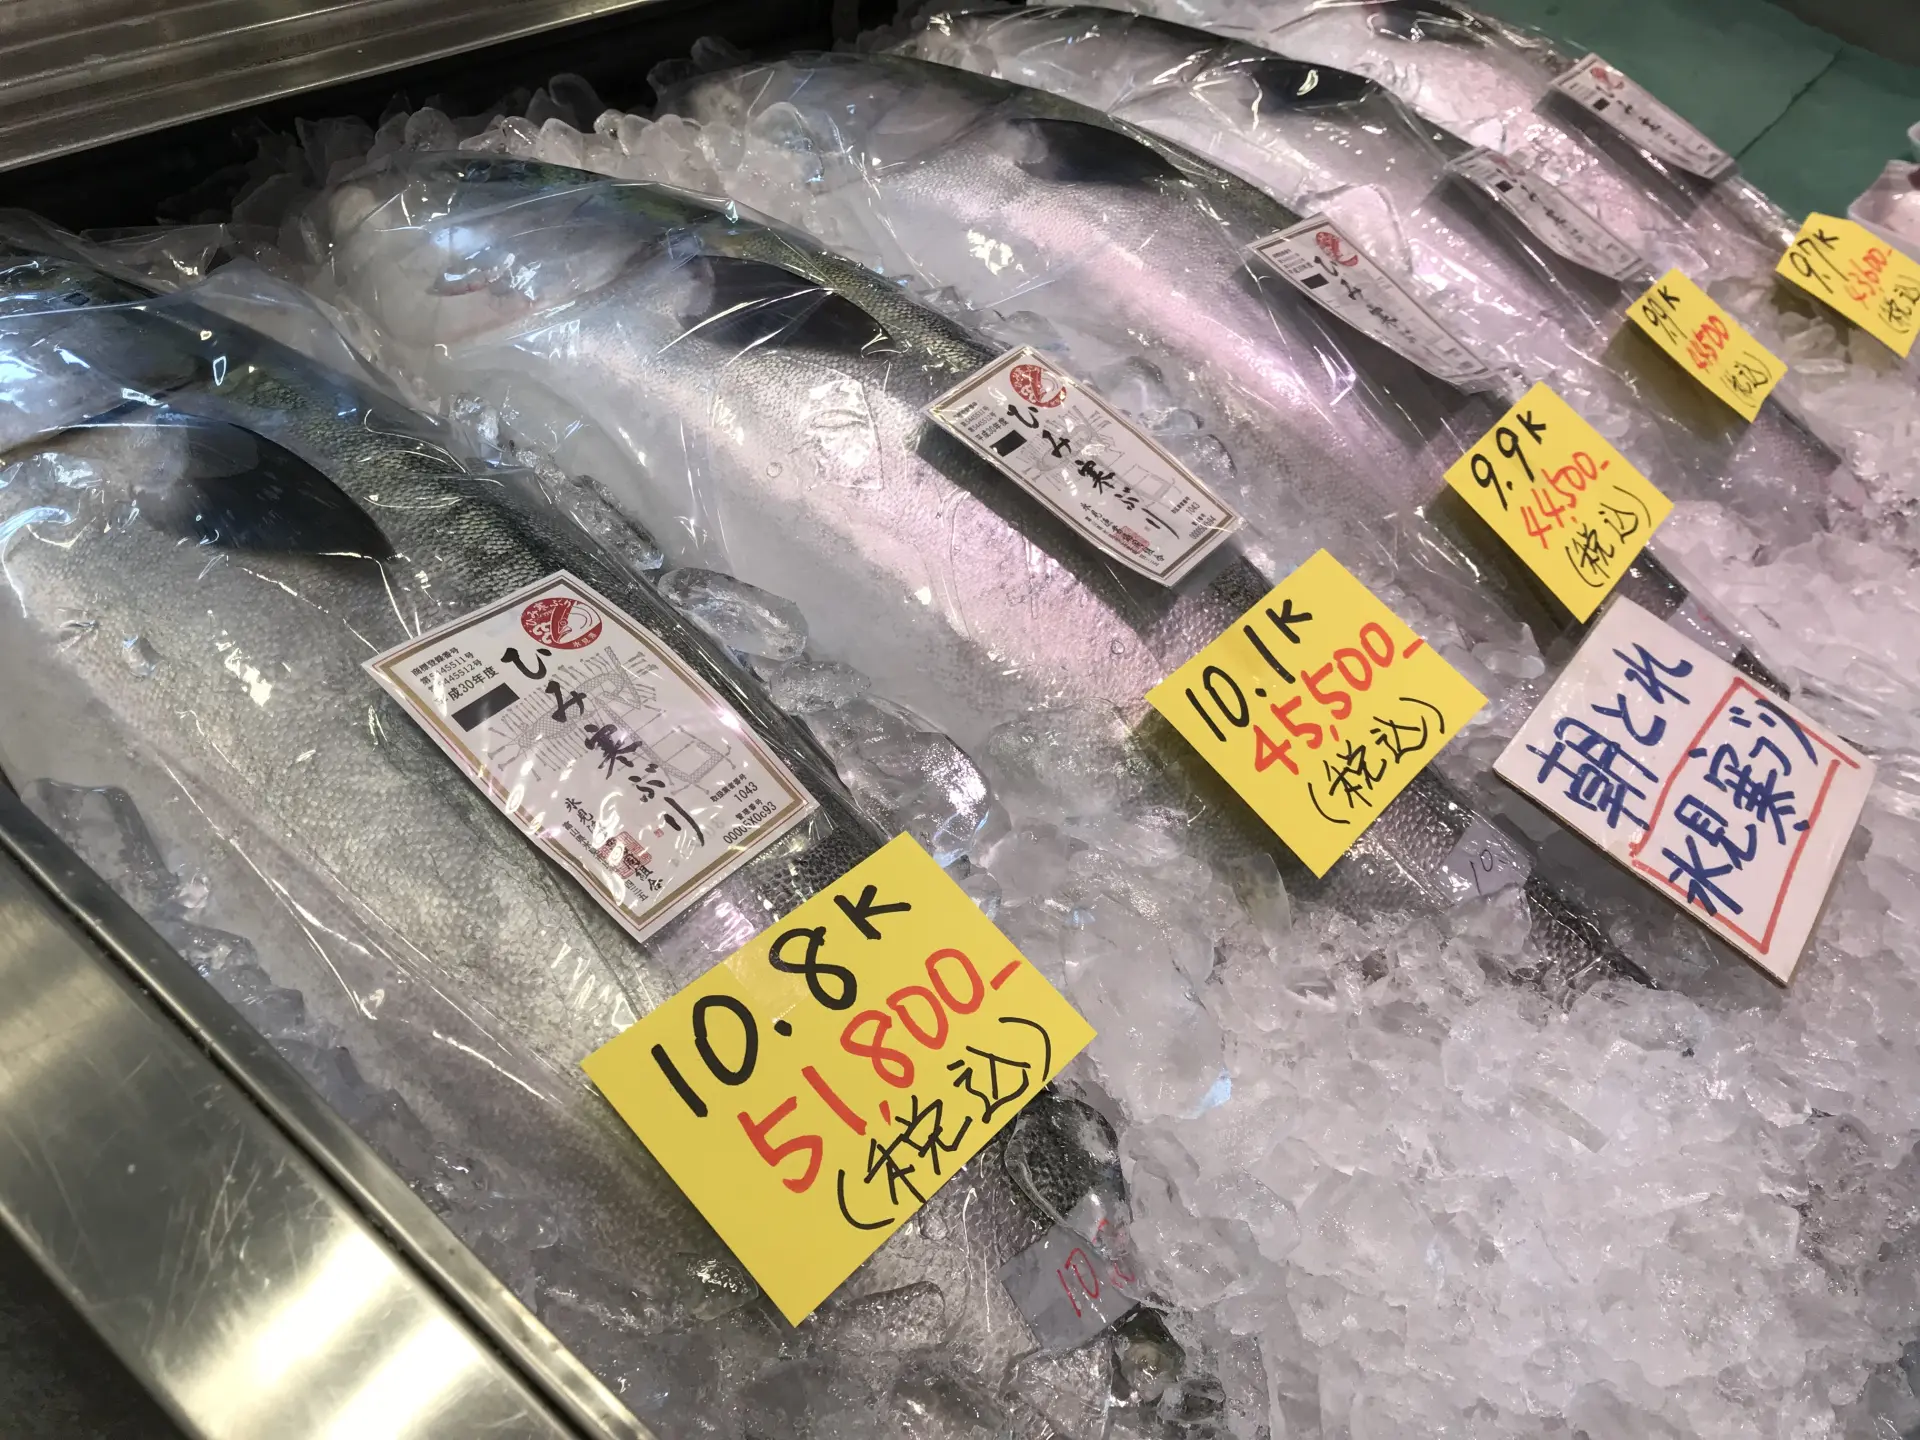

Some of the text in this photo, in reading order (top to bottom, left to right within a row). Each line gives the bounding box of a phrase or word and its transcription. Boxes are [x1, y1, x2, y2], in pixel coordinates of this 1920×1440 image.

[1789, 229, 1849, 294] 9.7K
[1007, 404, 1180, 539] ひみ寒ぶり
[1471, 411, 1546, 511] 9.9K
[1565, 485, 1651, 588] (税込)
[435, 666, 499, 705] 成30年度
[1186, 599, 1312, 742] 10.1K
[500, 647, 705, 847] ひみ寒ぶり
[734, 781, 758, 802] 1043
[1308, 697, 1444, 824] (税込)
[1526, 643, 1693, 830] 朝とれ
[651, 885, 911, 1117] 10.8K
[837, 1017, 1051, 1230] (税込)
